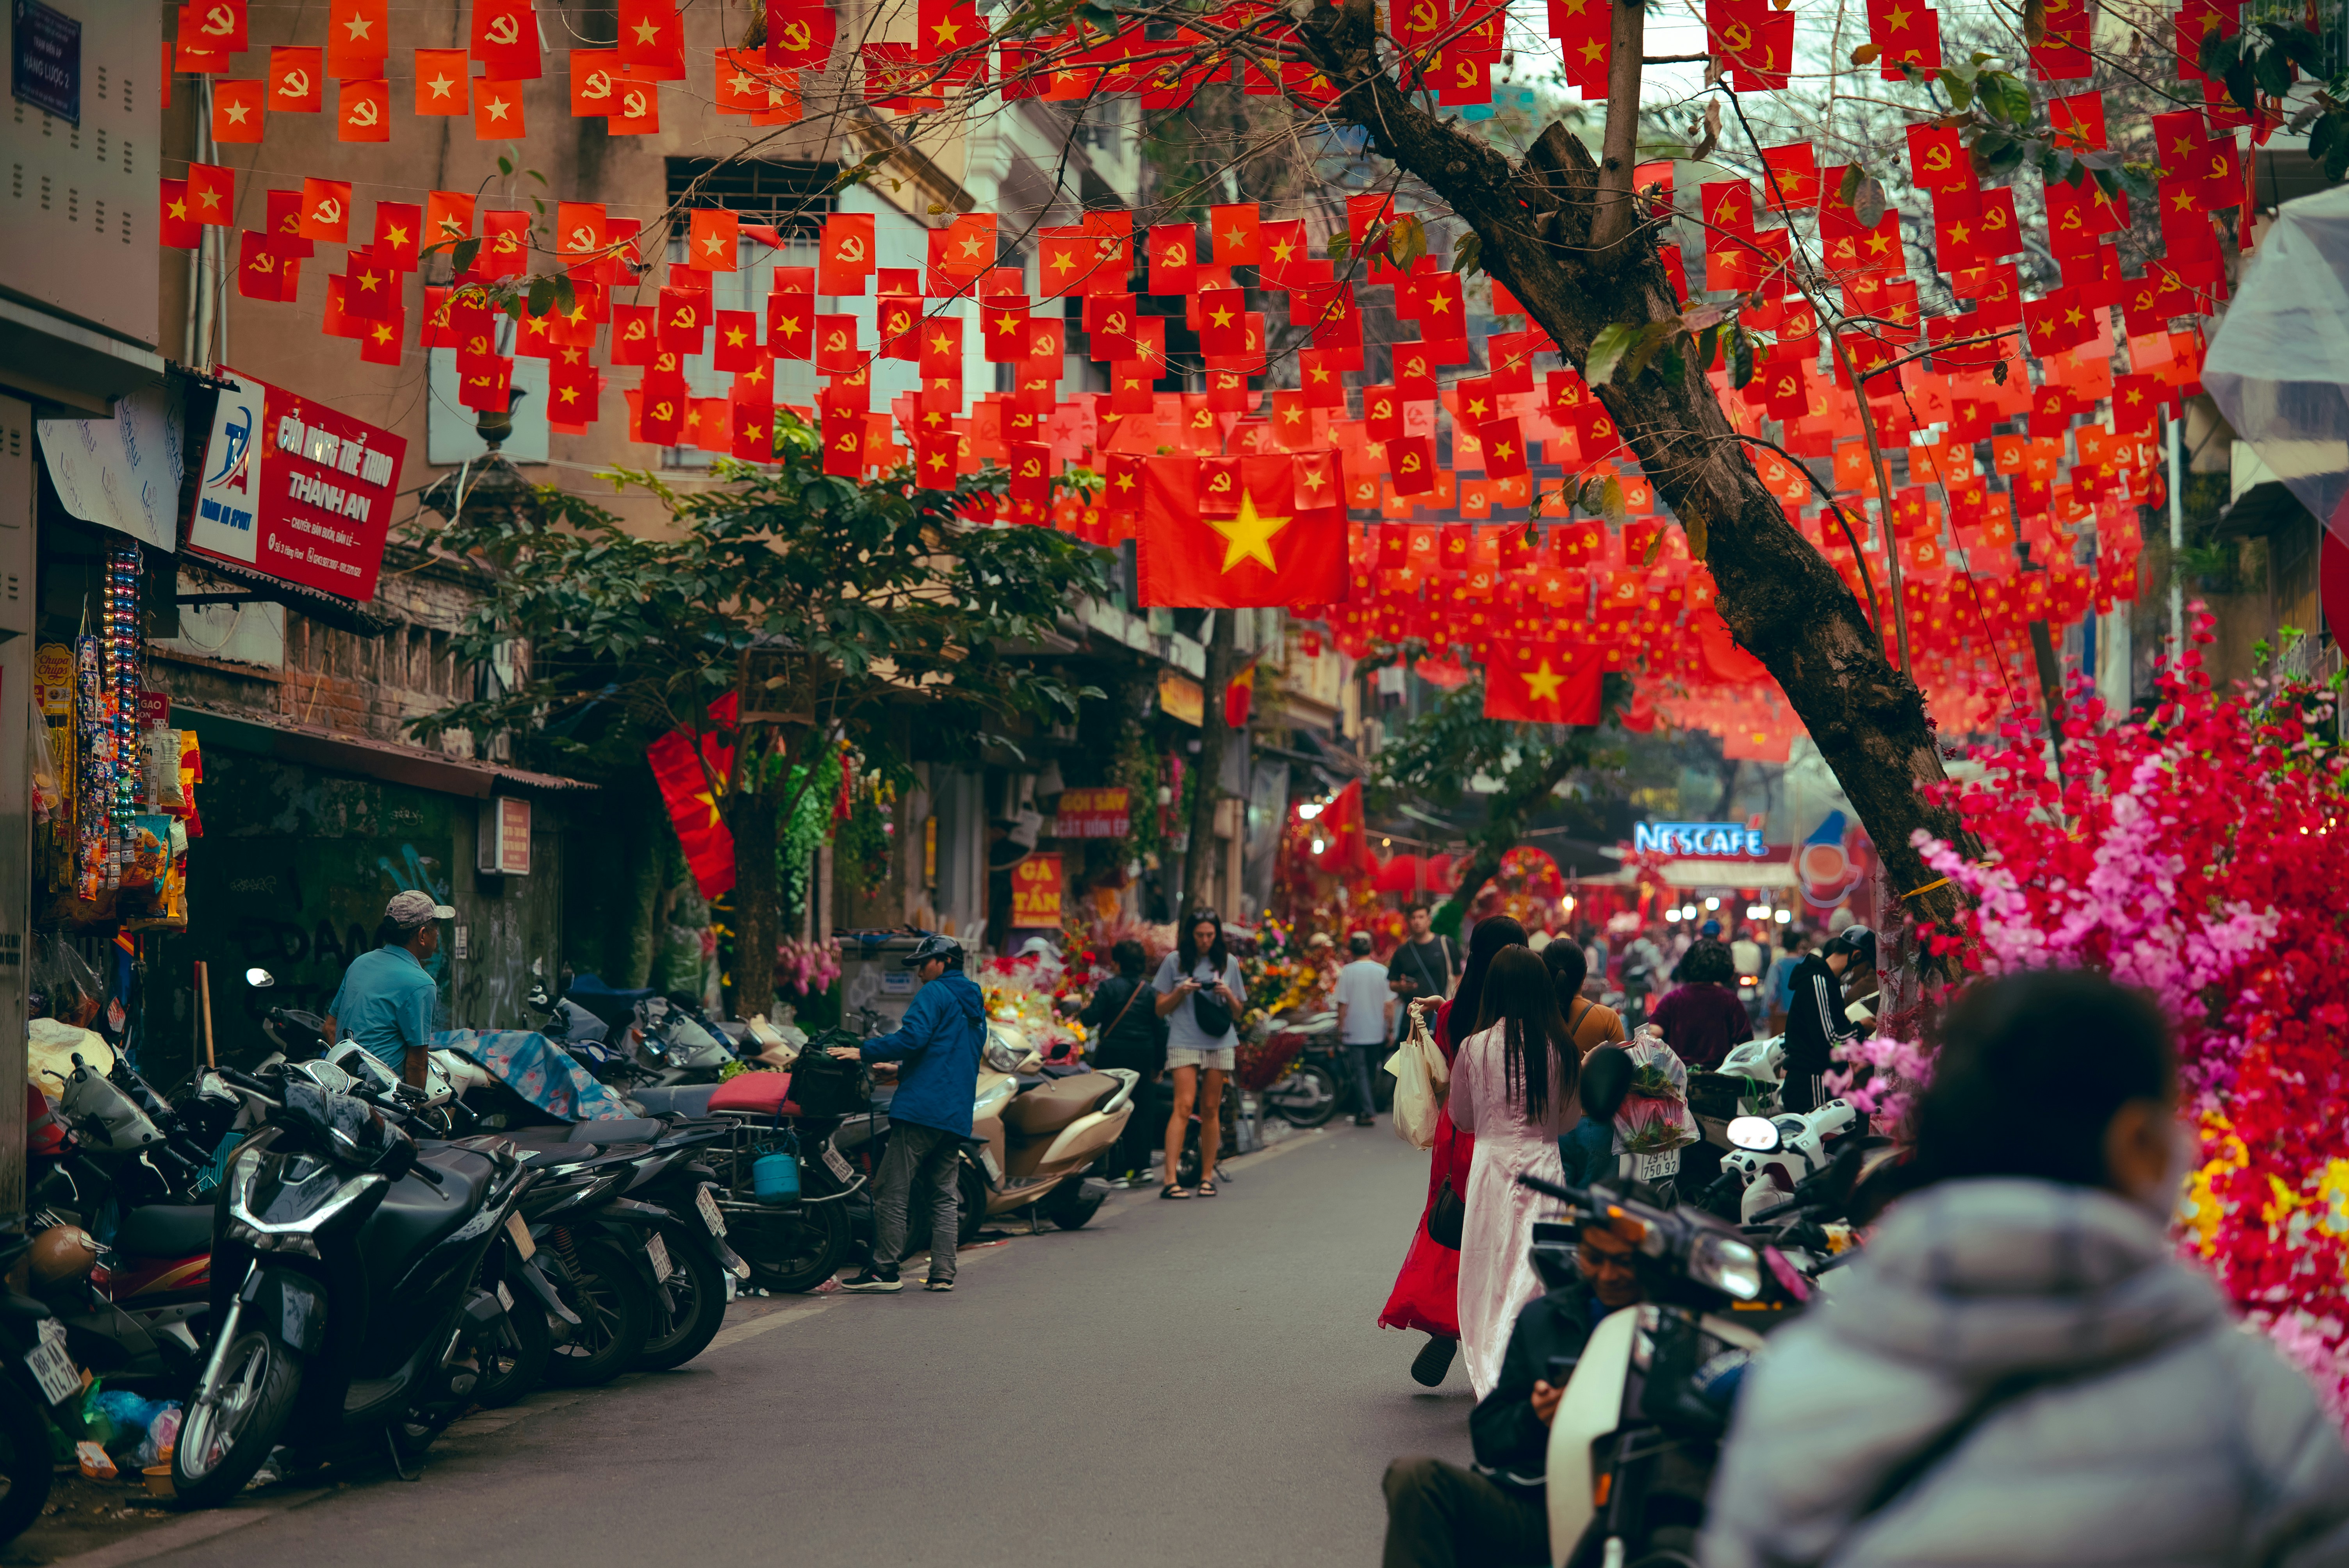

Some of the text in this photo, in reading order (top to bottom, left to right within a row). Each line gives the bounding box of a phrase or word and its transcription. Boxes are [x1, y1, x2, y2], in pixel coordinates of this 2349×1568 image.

[64, 73, 70, 89] 2
[276, 408, 394, 487] CỬA HÀNG THỂ THAO
[288, 471, 371, 523] THÀNH AN
[220, 506, 231, 525] AN
[230, 509, 252, 531] SPORT
[311, 522, 322, 536] BÁN
[335, 530, 346, 545] BÁN
[346, 532, 354, 547] LẺ
[274, 541, 281, 552] Số
[280, 544, 284, 554] 3
[38, 665, 68, 680] Chups
[39, 655, 69, 667] Chupa
[1644, 1160, 1676, 1178] 750.92
[655, 1254, 671, 1281] 273.19
[44, 1363, 78, 1401] 114.78
